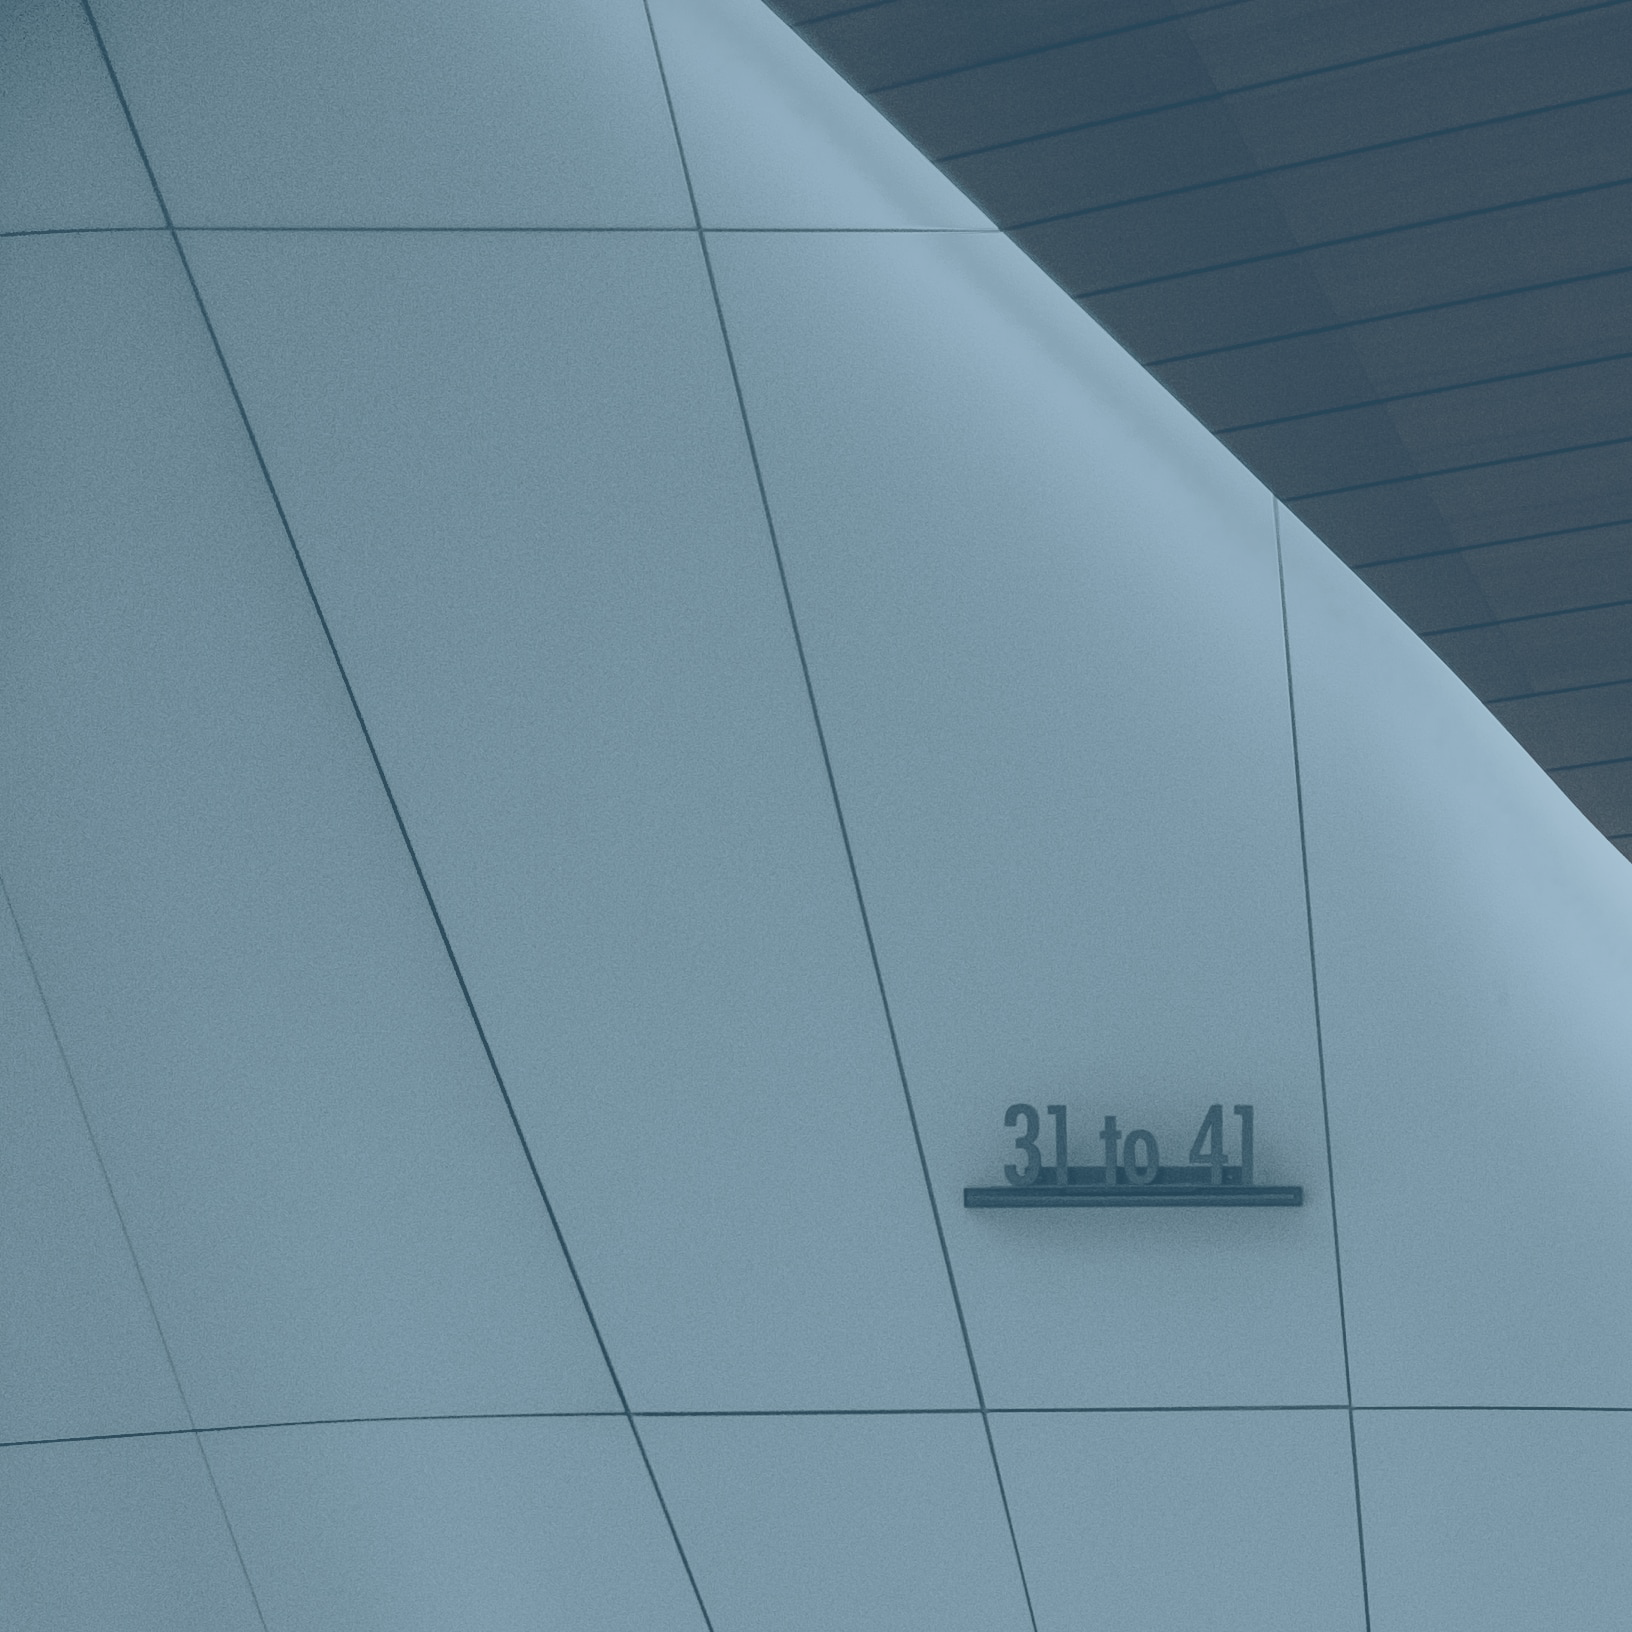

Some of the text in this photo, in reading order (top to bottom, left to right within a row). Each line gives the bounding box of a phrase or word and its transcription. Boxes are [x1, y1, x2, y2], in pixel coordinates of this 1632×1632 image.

[1003, 1102, 1254, 1186] 31 to 41
